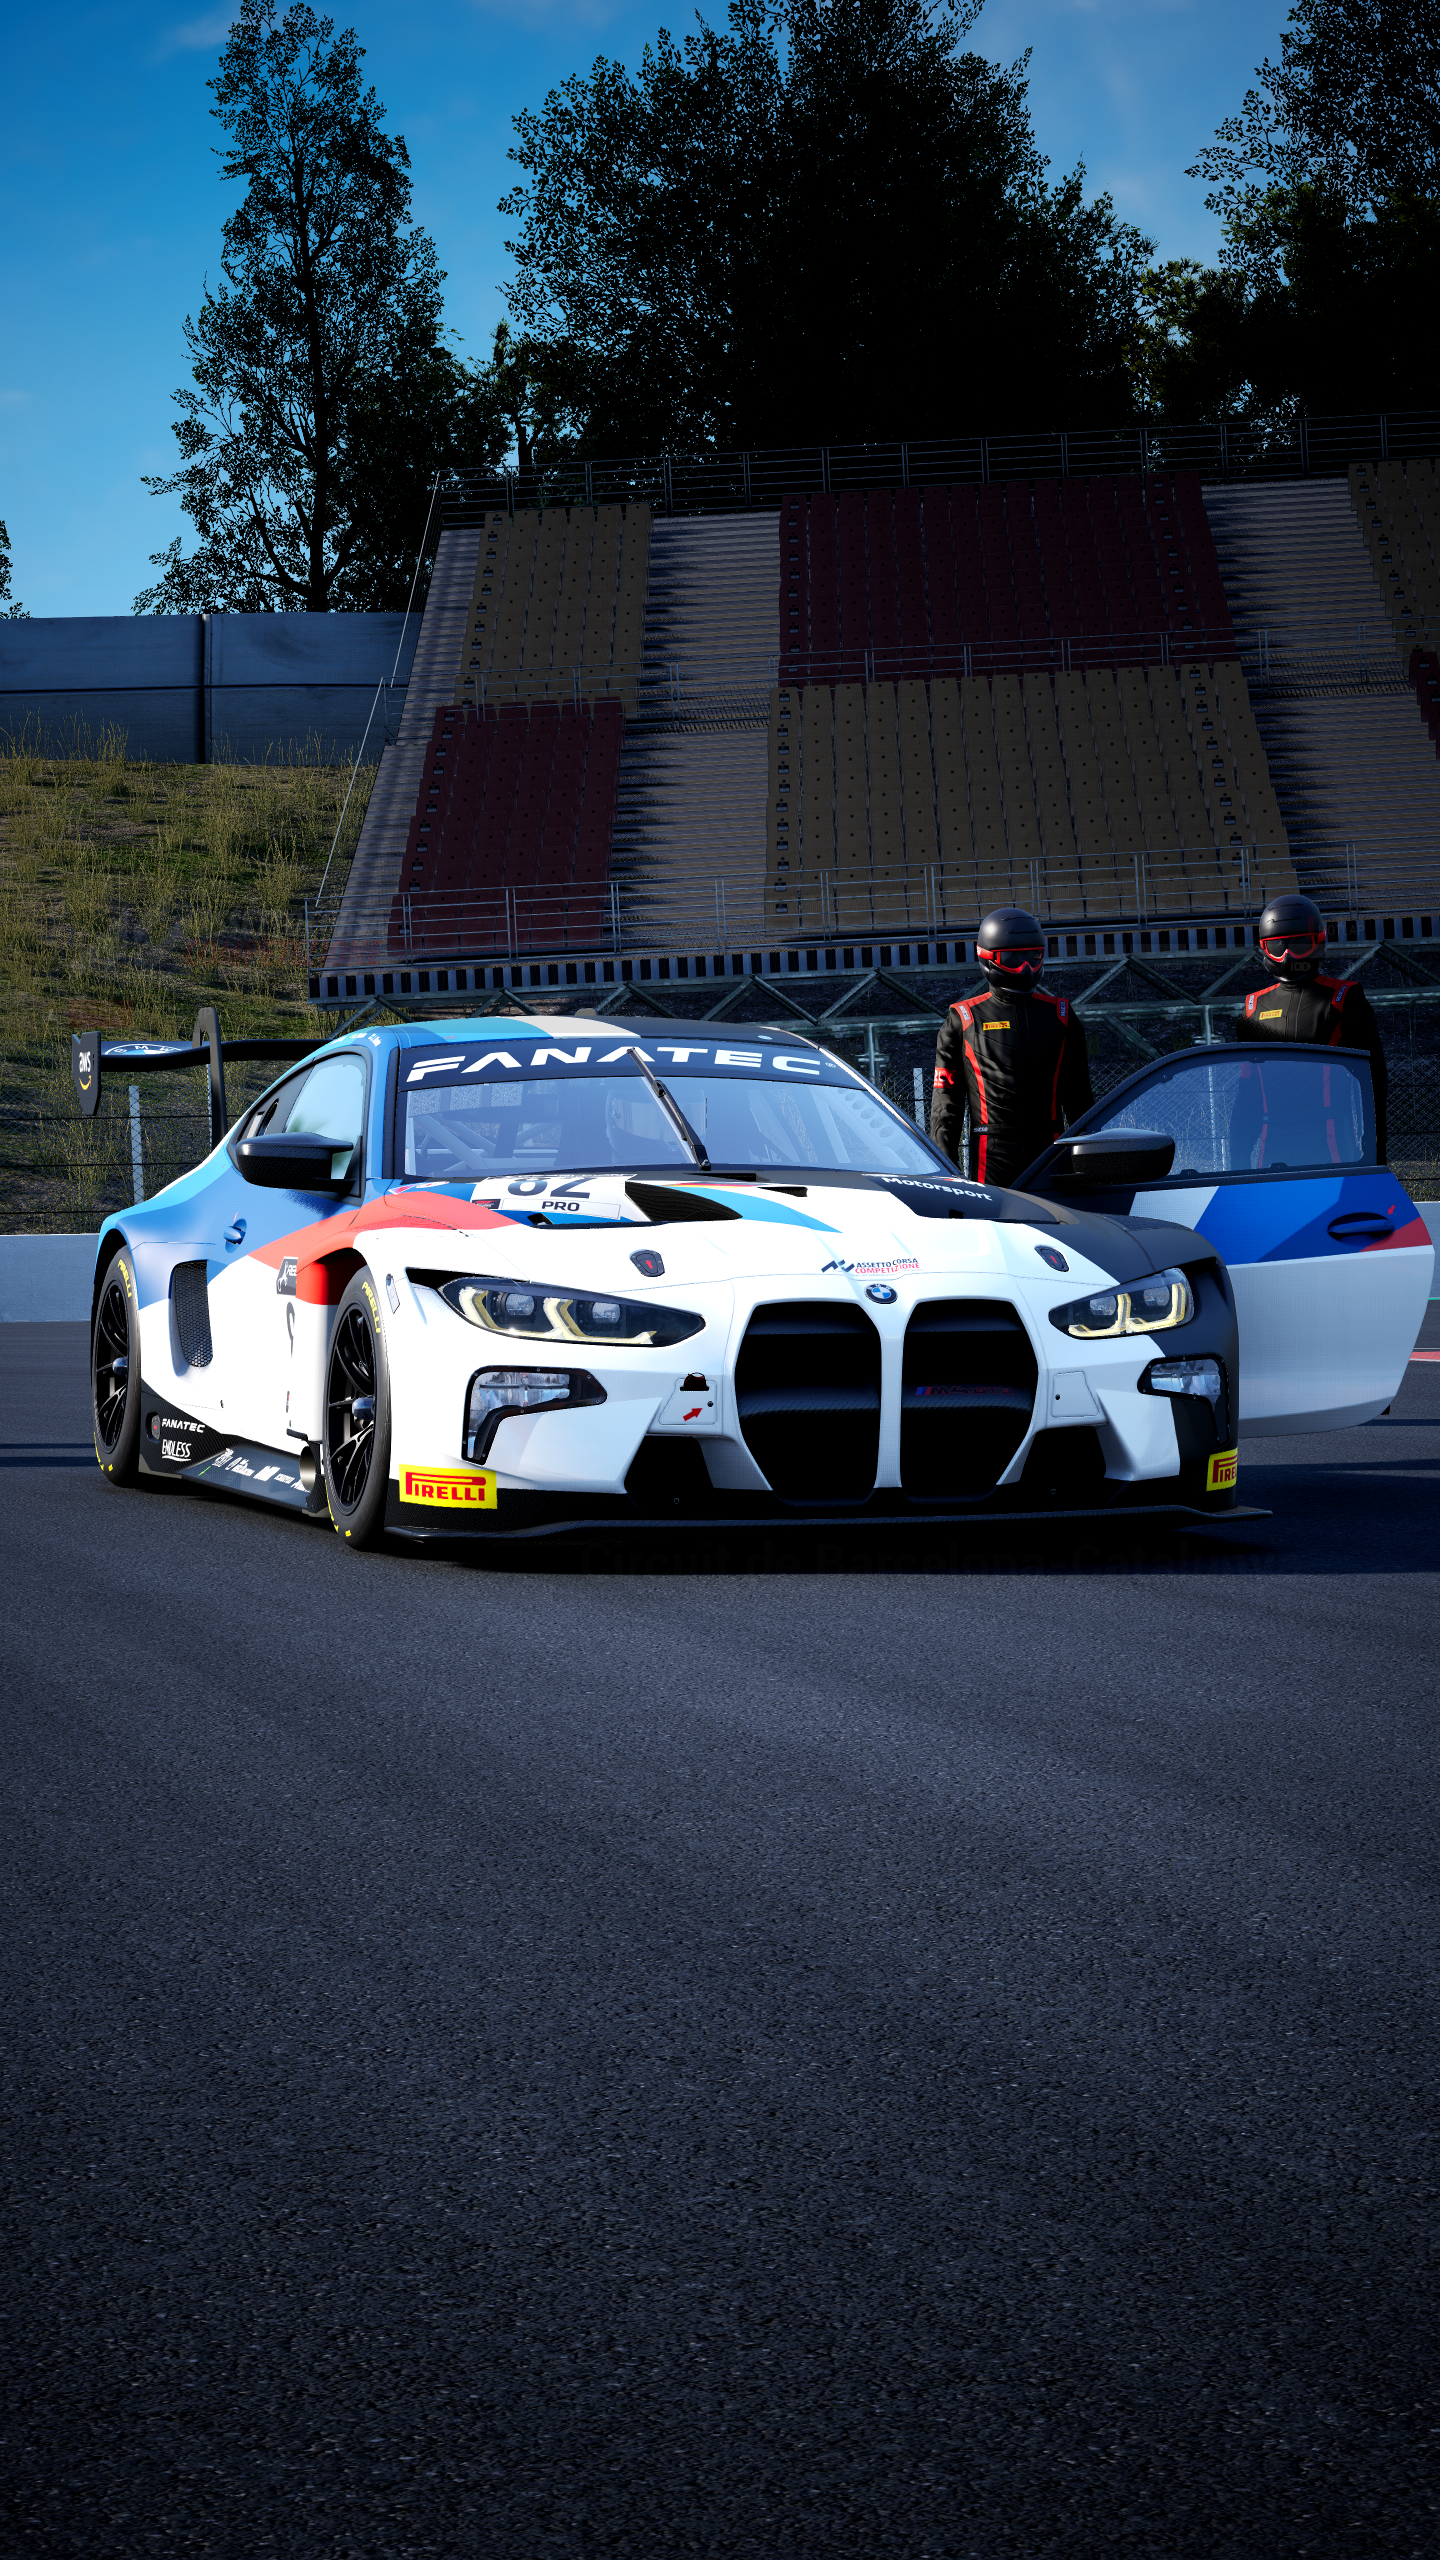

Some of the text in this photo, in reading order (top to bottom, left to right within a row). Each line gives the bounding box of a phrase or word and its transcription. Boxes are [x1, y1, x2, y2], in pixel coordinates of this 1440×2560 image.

[78, 1051, 92, 1073] aws
[406, 1046, 821, 1083] FANATEC
[881, 1177, 993, 1201] Motorsport
[541, 1200, 580, 1212] PRO
[854, 1262, 920, 1274] COMPETIZIONE
[892, 1257, 919, 1266] CORSA
[361, 1281, 382, 1333] PIRELLI
[162, 1418, 206, 1434] FANATEC
[162, 1439, 192, 1459] ENDLESS
[405, 1471, 487, 1502] PIRELLI
